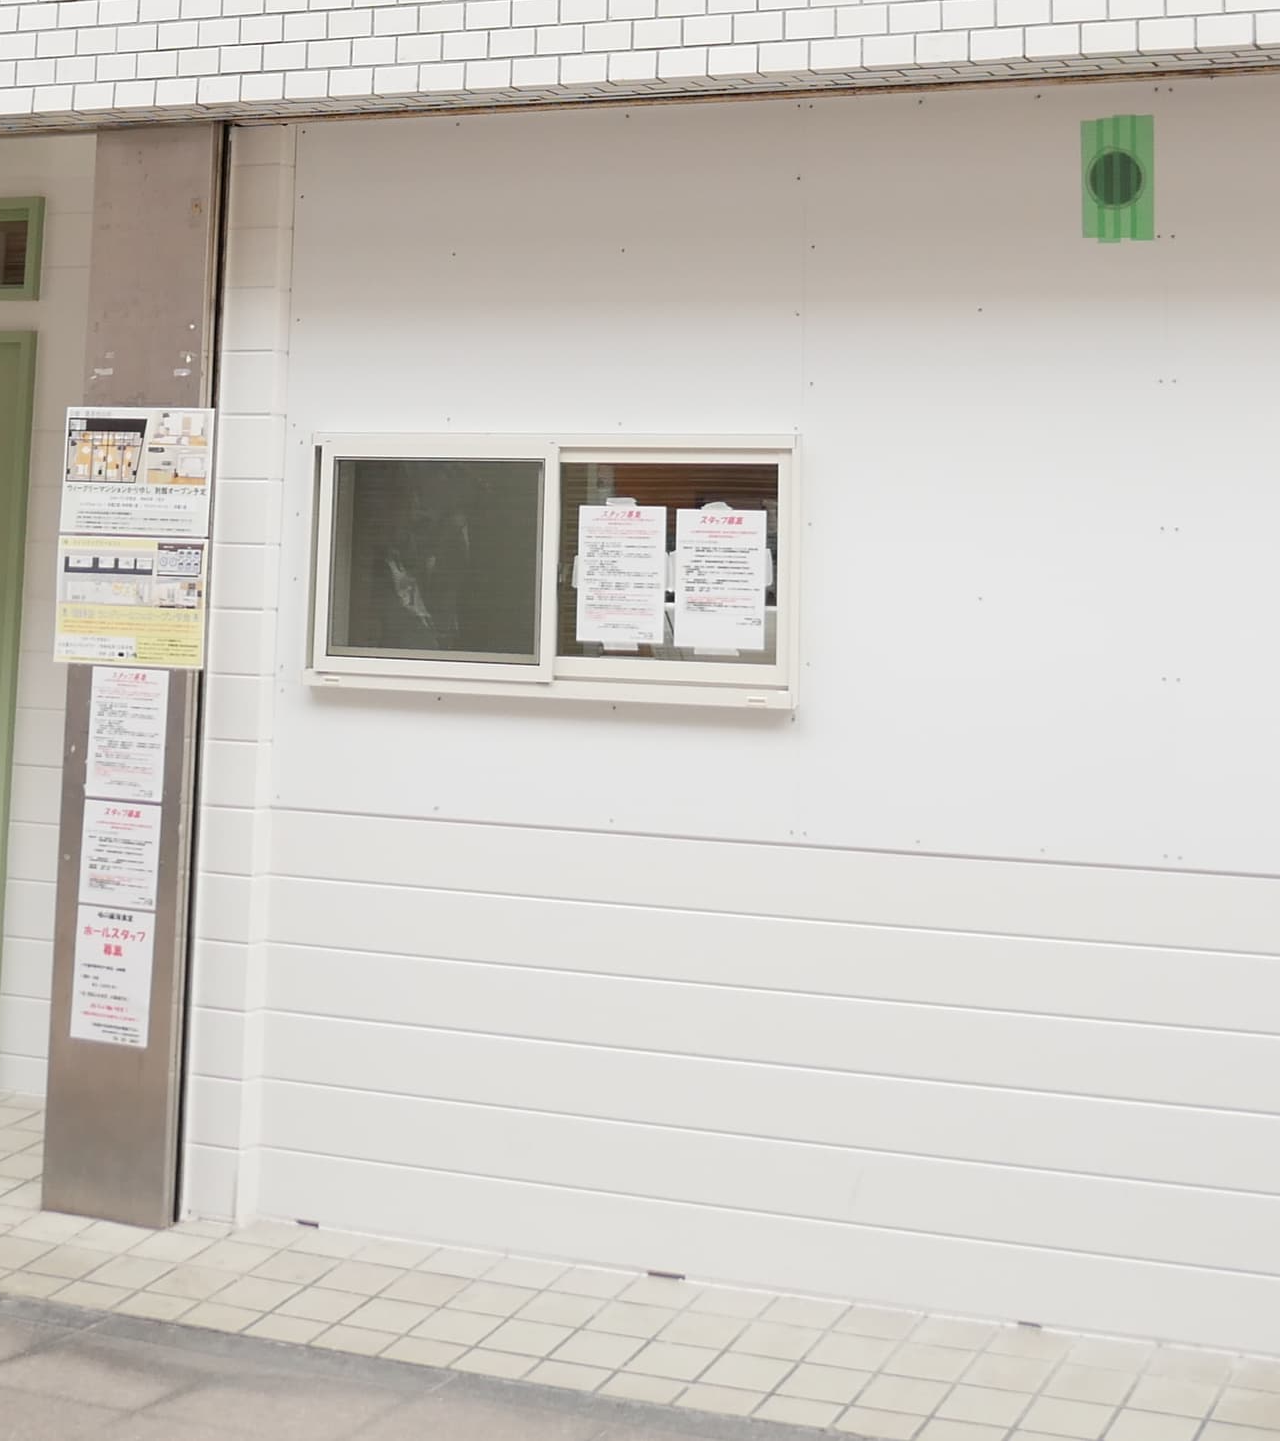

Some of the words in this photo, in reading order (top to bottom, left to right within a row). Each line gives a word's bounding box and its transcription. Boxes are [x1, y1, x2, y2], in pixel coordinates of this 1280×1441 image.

[601, 510, 641, 519] スタッフ募集
[699, 515, 744, 526] スタッフ募集
[83, 925, 146, 942] ホールスタッフ
